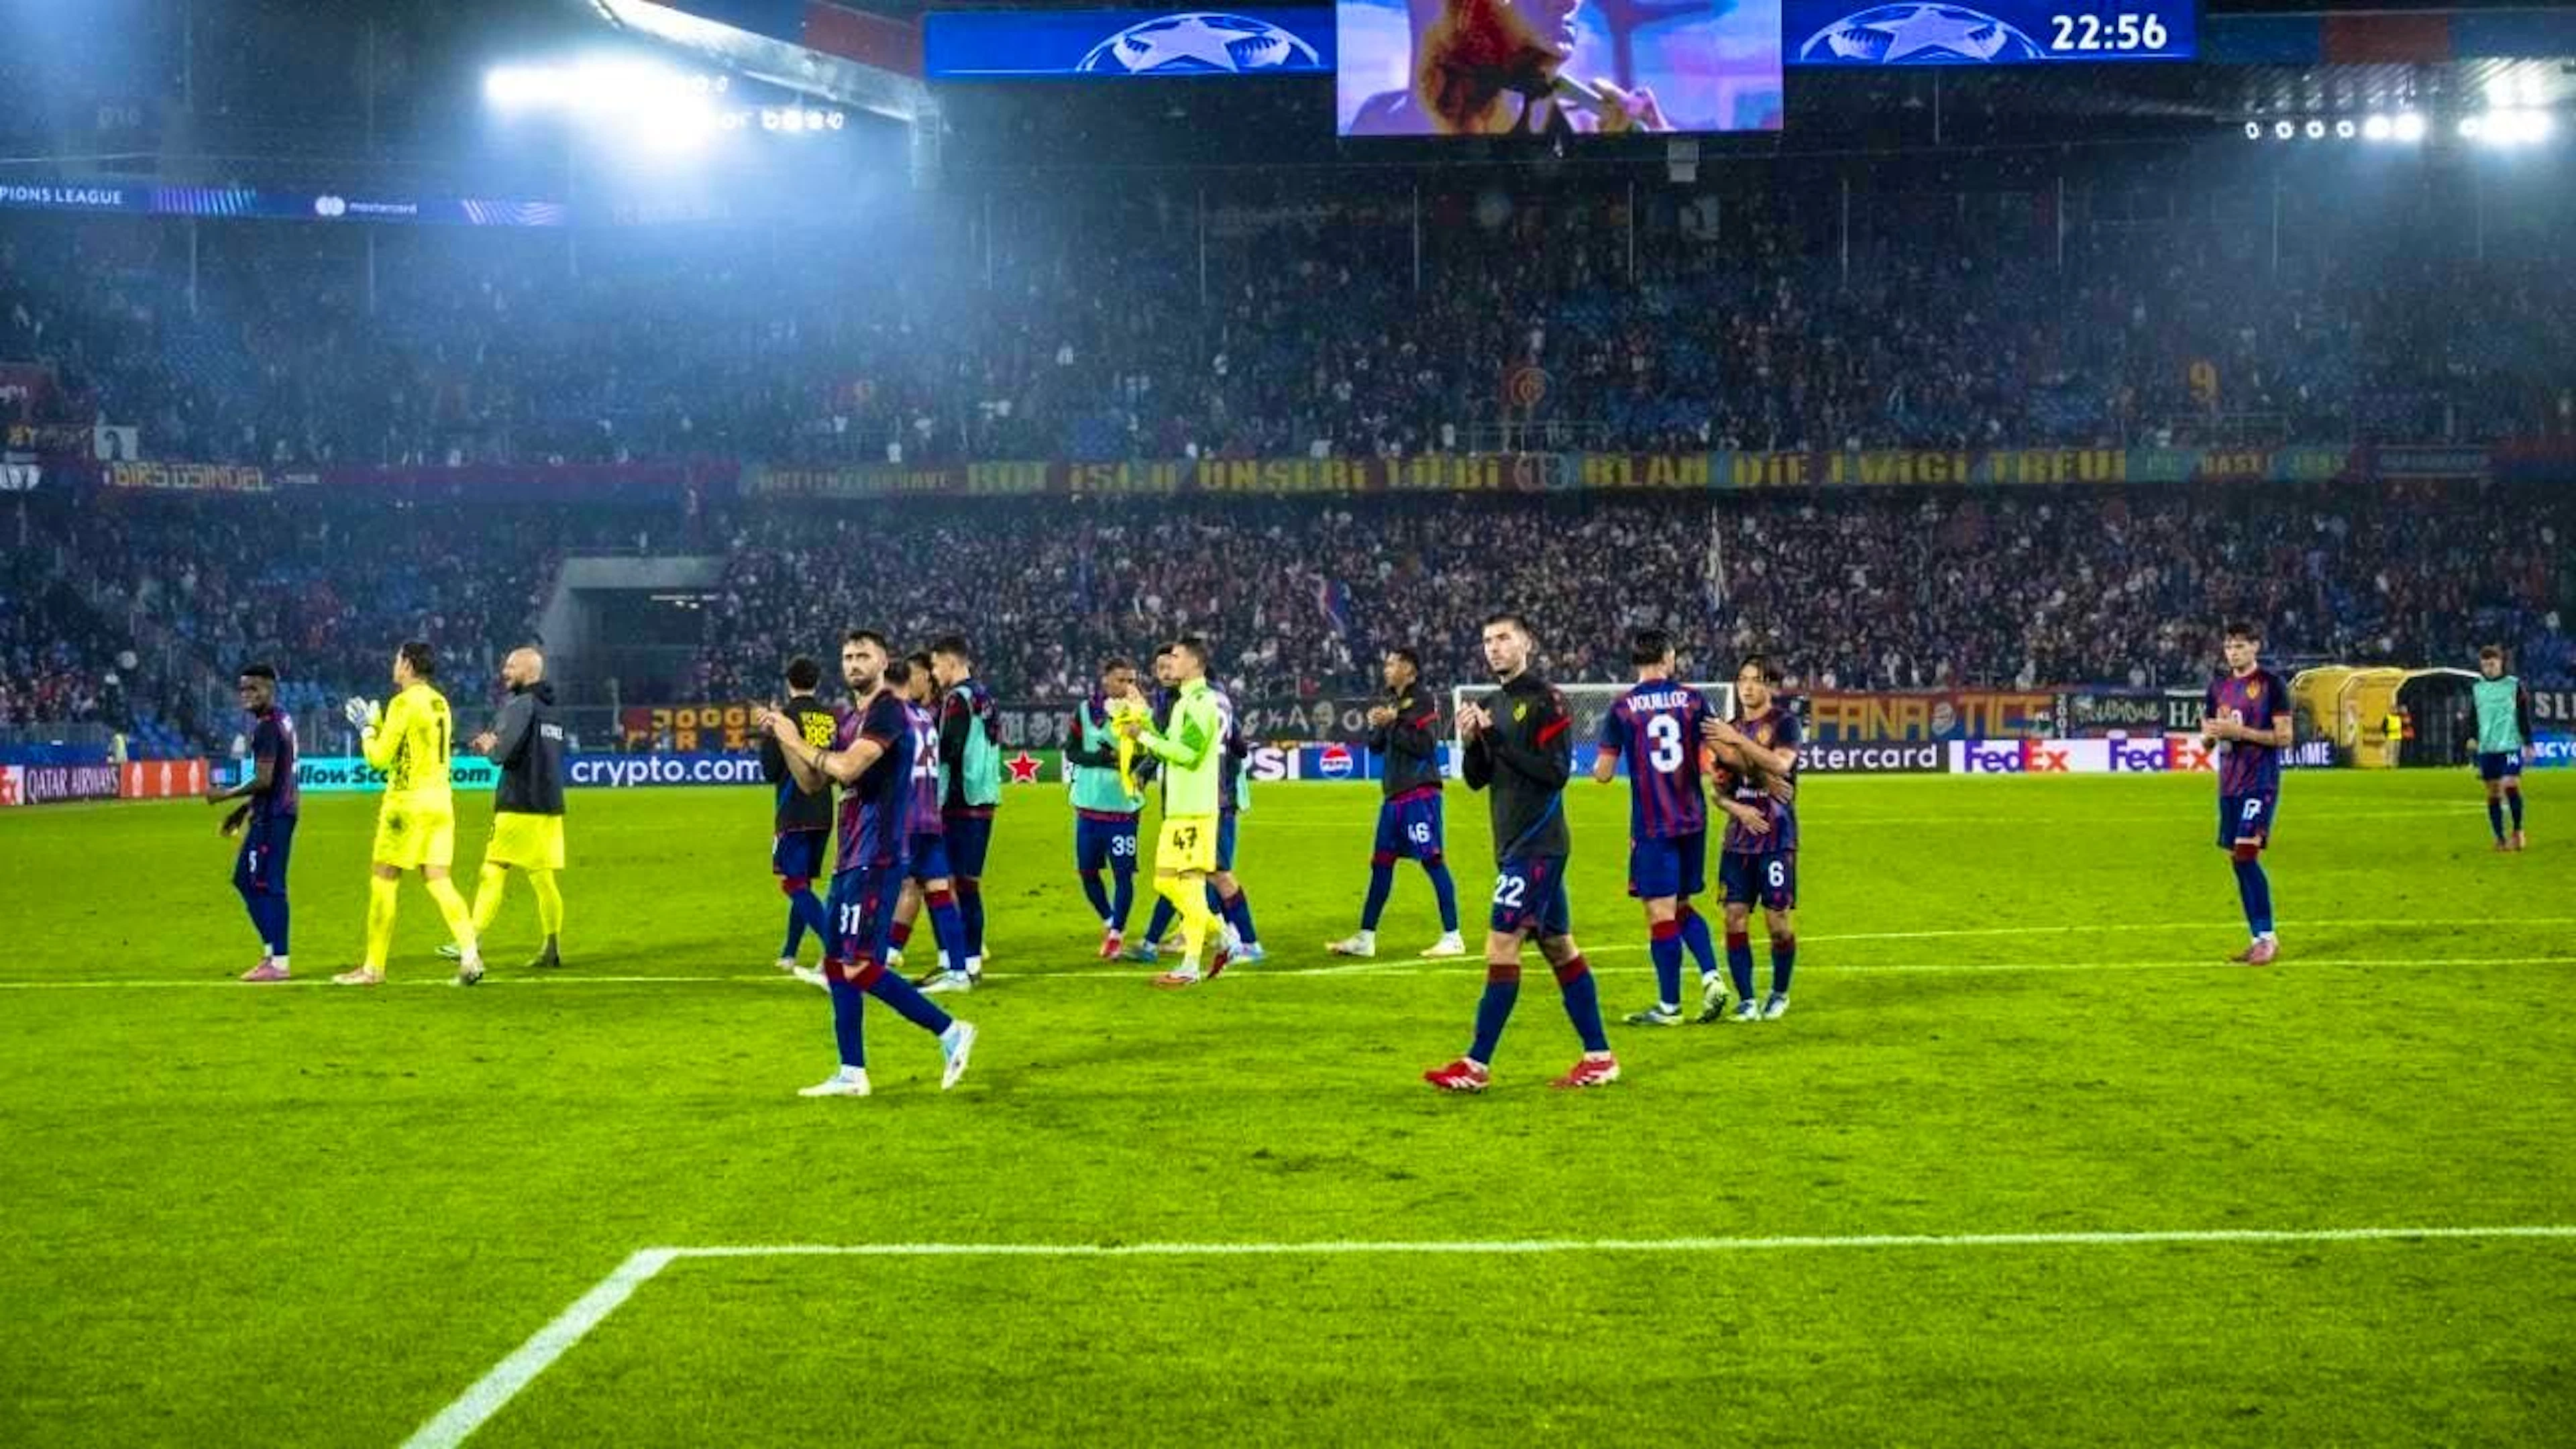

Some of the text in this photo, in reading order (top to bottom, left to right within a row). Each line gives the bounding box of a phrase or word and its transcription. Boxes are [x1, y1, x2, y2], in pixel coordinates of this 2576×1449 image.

[2051, 13, 2167, 50] 22:56
[55, 188, 123, 205] LEAGUE
[1627, 692, 1690, 712] VOUILLOZ
[435, 717, 445, 764] 1
[1648, 714, 1684, 773] 3
[1964, 738, 2068, 772] FedEx
[2109, 738, 2213, 771] FedEx
[26, 769, 68, 803] QATAR
[572, 753, 766, 787] crypto.com
[1112, 835, 1136, 857] 39
[1173, 826, 1197, 851] 47
[1768, 860, 1785, 887] 6
[1493, 874, 1525, 908] 22
[839, 902, 863, 936] 31
